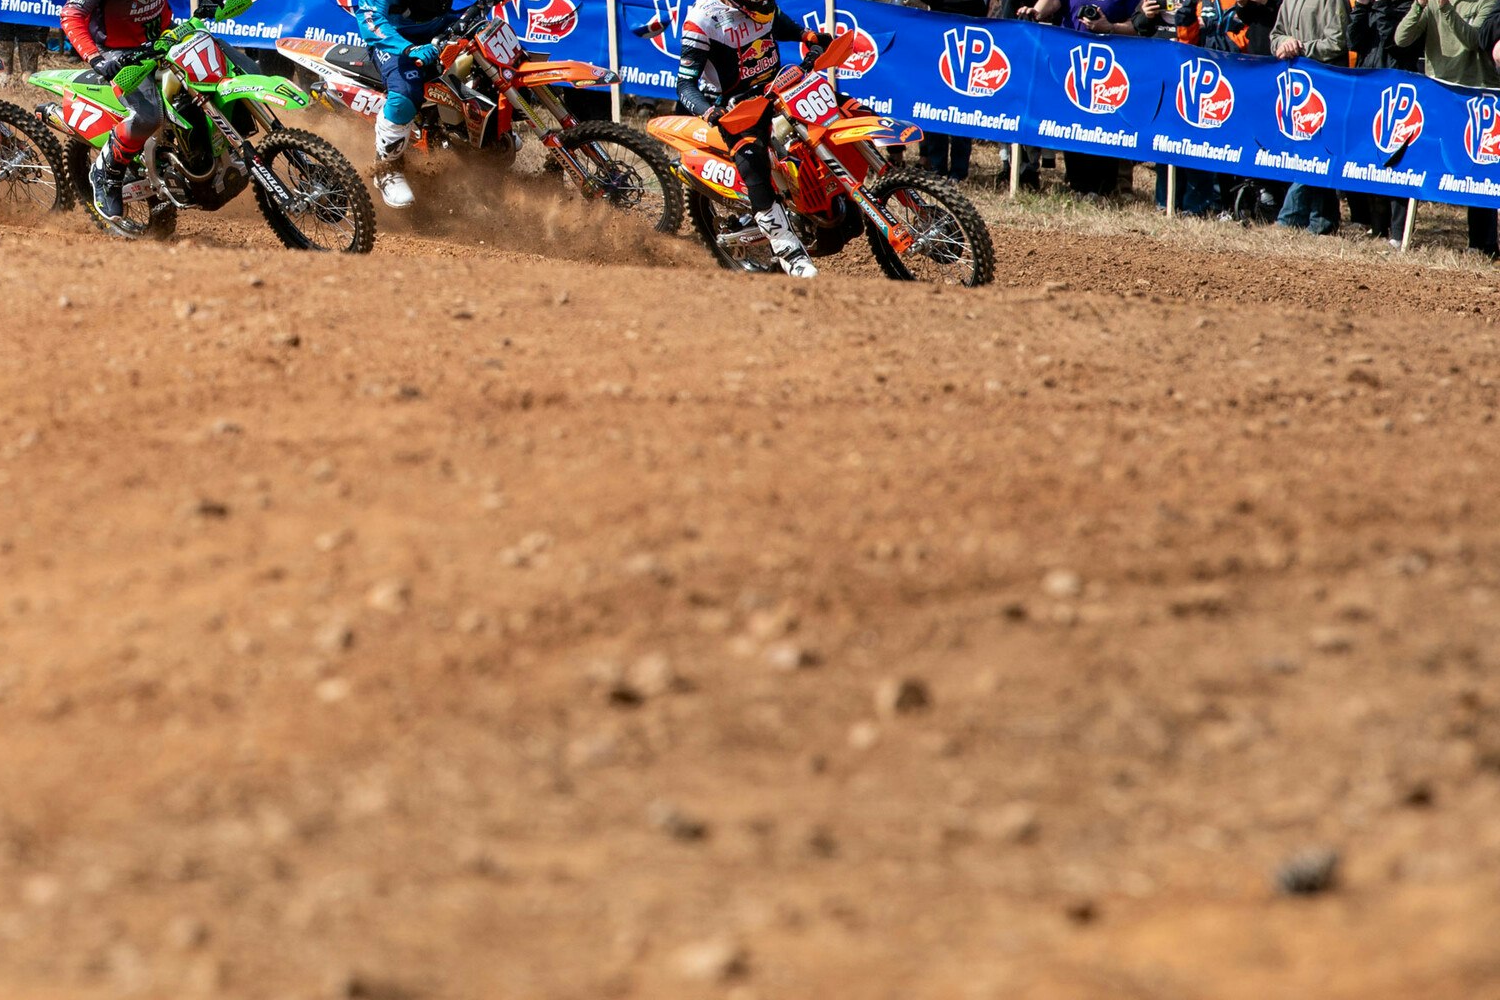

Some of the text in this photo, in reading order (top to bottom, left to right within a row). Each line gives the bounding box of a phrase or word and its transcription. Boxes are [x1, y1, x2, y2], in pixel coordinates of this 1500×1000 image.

[486, 25, 521, 65] 514
[530, 33, 560, 43] FUELS
[182, 35, 220, 82] 17
[297, 56, 332, 76] DUNLOP
[740, 60, 763, 79] Red
[943, 25, 995, 94] VP
[973, 66, 1011, 86] Racing
[1070, 43, 1115, 111] VP
[795, 83, 838, 123] 969
[971, 86, 995, 96] FUELS
[1094, 83, 1128, 103] Racing
[1180, 57, 1222, 126] VP
[1276, 68, 1313, 137] VP
[67, 100, 103, 132] 17
[912, 101, 1021, 131] #MoreThanRaceFuel
[1093, 103, 1116, 112] FUELS
[1202, 98, 1233, 118] Racing
[1381, 83, 1417, 151] VP
[1038, 119, 1138, 148] #MoreThanRaceFuel
[1201, 118, 1221, 127] FUELS
[1467, 93, 1498, 162] VP
[1152, 134, 1243, 163] #MoreThanRaceFuel
[701, 159, 736, 188] 969
[1342, 160, 1426, 188] #MoreThanRaceFuel
